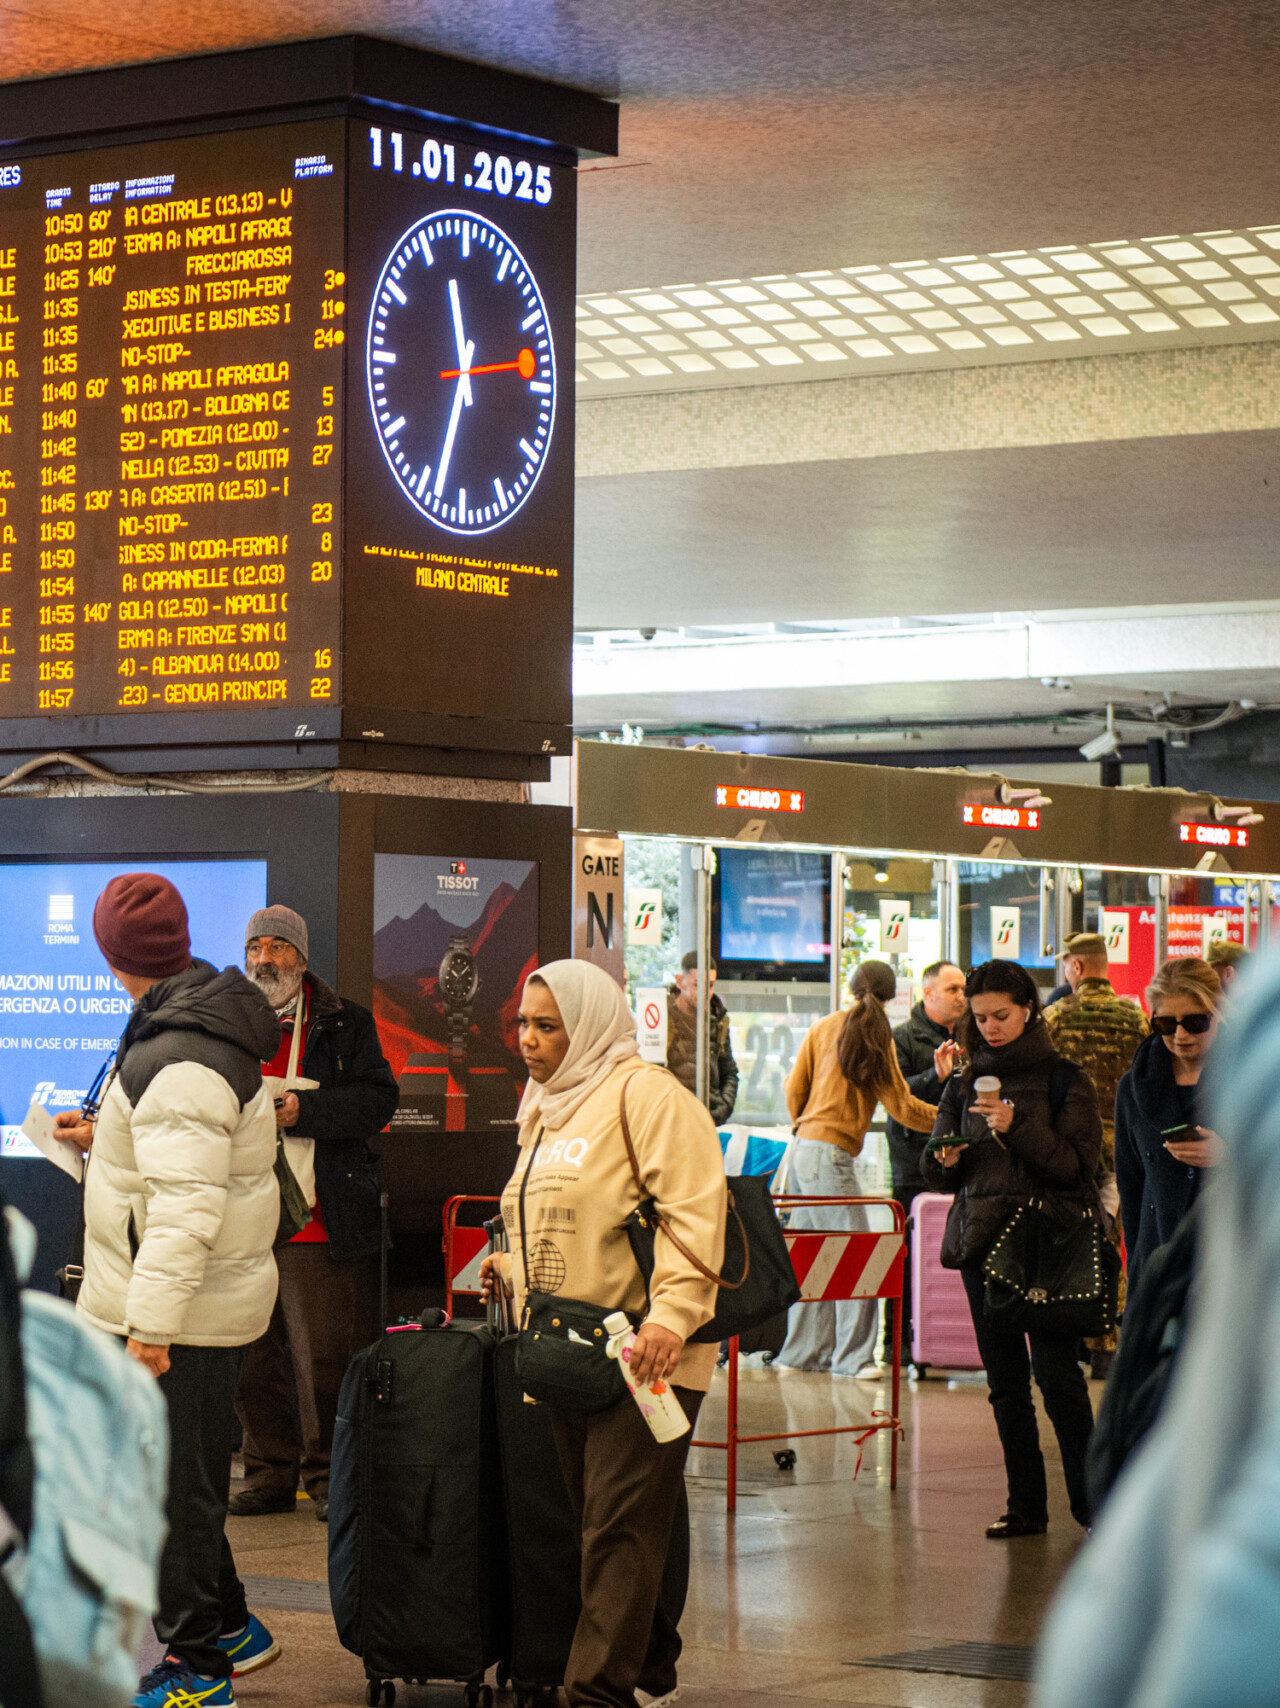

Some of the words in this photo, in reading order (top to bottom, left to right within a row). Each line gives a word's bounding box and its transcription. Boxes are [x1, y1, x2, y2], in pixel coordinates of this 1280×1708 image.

[295, 155, 326, 168] BINARIO
[295, 164, 333, 179] PLATFORM
[46, 187, 71, 199] ORARIO
[89, 181, 120, 194] RITARDO
[125, 174, 175, 189] INFORMAZIONI
[125, 185, 172, 200] INFORMATION
[46, 198, 63, 209] TIME
[89, 191, 113, 204] DELAY
[45, 213, 84, 237] 10:50
[141, 196, 212, 225] CENTRALE
[215, 190, 264, 216] (13.13)
[44, 240, 83, 264] 10:53
[185, 222, 237, 248] NAPOLI
[43, 268, 80, 292] 11:25
[186, 245, 292, 277] FRECCIAROSSA
[43, 296, 79, 320] 11:35
[324, 269, 335, 291] 3
[42, 324, 78, 348] 11:35
[208, 304, 280, 331] BUSINESS
[321, 298, 335, 320] 11
[42, 352, 78, 376] 11:35
[121, 342, 192, 368] NO-STOP-
[313, 327, 335, 350] 24
[41, 380, 78, 403] 11:40
[161, 367, 213, 393] NAPOLI
[215, 360, 290, 387] AFRAGOLA
[41, 408, 77, 431] 11:40
[140, 398, 189, 422] (13.17)
[204, 391, 270, 417] BOLOGNA
[322, 385, 334, 407] 5
[40, 436, 77, 459] 11:42
[161, 424, 223, 449] POMEZIA
[226, 419, 279, 444] (12.00)
[316, 415, 334, 437] 13
[40, 464, 77, 487] 11:42
[121, 457, 165, 481] NELLA
[167, 453, 220, 477] (12.53)
[312, 443, 334, 466] 27
[40, 492, 76, 514] 11:45
[150, 482, 215, 506] CASERTA
[217, 478, 267, 502] (12.51)
[39, 520, 76, 542] 11:50
[118, 512, 189, 537] NO-STOP-
[311, 502, 333, 524] 23
[39, 548, 76, 570] 11:50
[188, 535, 279, 561] CODA-FERMA
[320, 531, 333, 553] 8
[39, 576, 75, 598] 11:54
[141, 566, 230, 592] CAPANNELLE
[232, 563, 286, 587] (12.03)
[311, 560, 333, 582] 20
[416, 566, 455, 590] MILANO
[457, 571, 509, 597] CENTRALE
[39, 604, 75, 626] 11:55
[118, 599, 154, 622] GOLA
[157, 596, 209, 619] (12.50)
[224, 592, 277, 616] NAPOLI
[39, 632, 75, 654] 11:55
[117, 628, 155, 650] ERMA
[176, 623, 238, 647] FIRENZE
[240, 622, 270, 644] SMN
[38, 660, 75, 681] 11:56
[151, 653, 225, 676] ALBANOVA
[227, 650, 280, 673] (14.00)
[314, 648, 332, 669] 16
[38, 687, 75, 709] 11:57
[163, 681, 220, 704] GENOVA
[310, 677, 332, 698] 22
[737, 788, 780, 810] CHIUSO
[981, 807, 1020, 826] CHIUSO
[1196, 825, 1230, 845] CHIUSO
[582, 855, 619, 877] GATE
[437, 875, 479, 890] TISSOT
[48, 923, 74, 933] ROMA
[586, 891, 614, 950] N
[43, 935, 80, 945] TERMINI
[58, 975, 91, 991] UTILI
[95, 975, 111, 991] IN
[64, 997, 76, 1014] O
[21, 1038, 32, 1049] IN
[35, 1038, 61, 1050] CASE
[63, 1038, 79, 1050] OF
